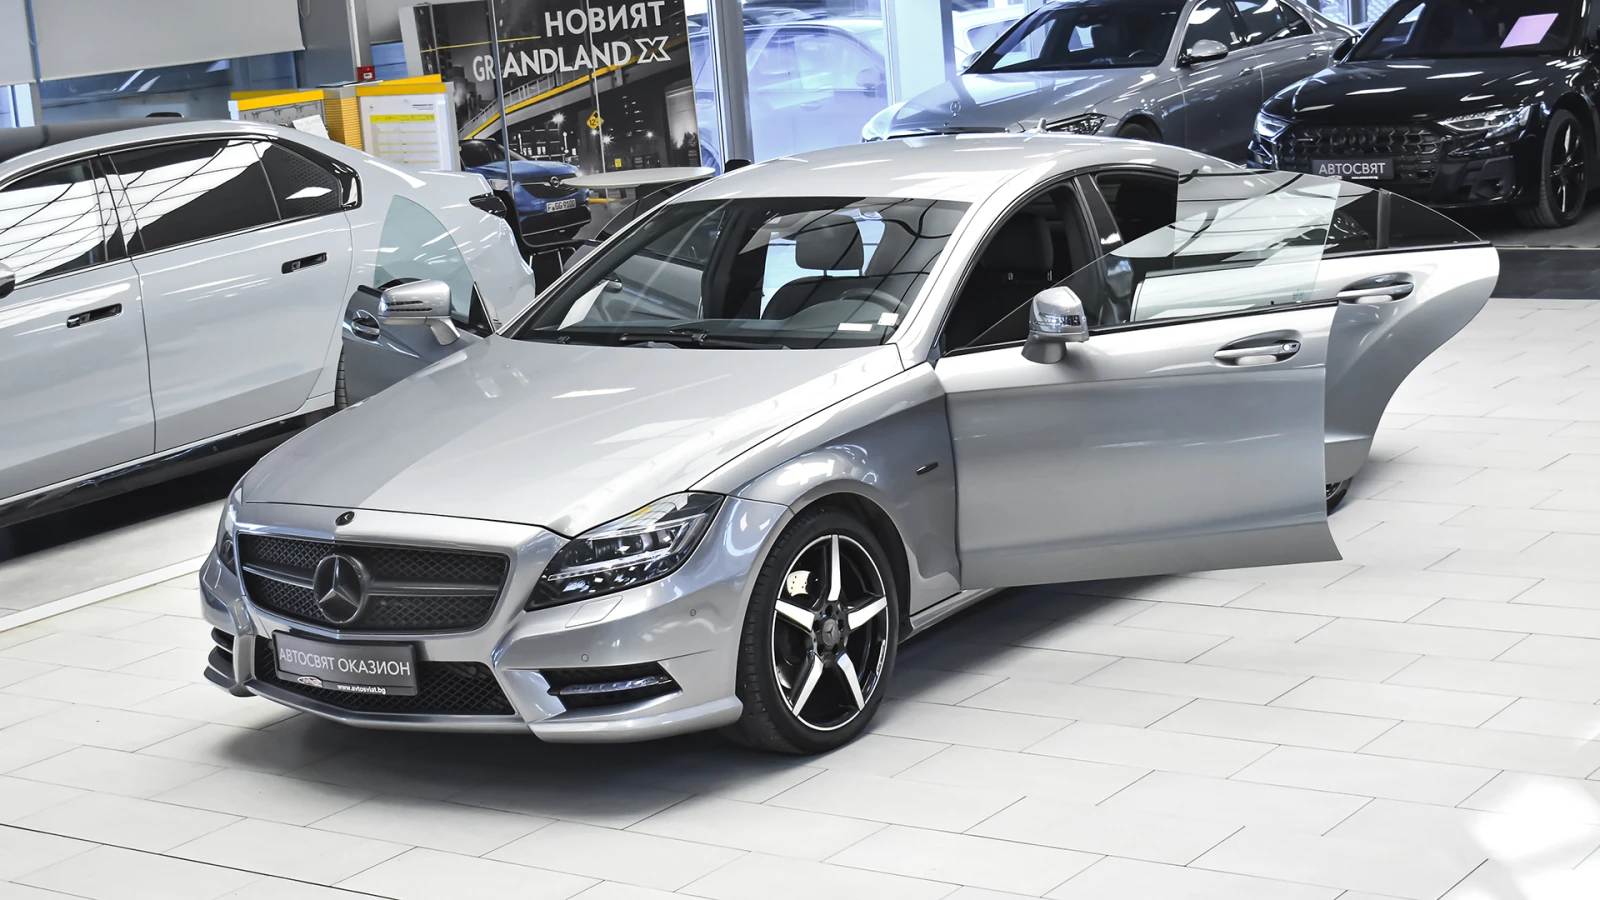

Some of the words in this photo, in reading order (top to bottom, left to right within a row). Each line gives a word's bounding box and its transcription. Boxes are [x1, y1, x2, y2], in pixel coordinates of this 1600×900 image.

[544, 1, 665, 37] НОВИЯТ
[1318, 162, 1386, 175] АВТОСВЯТ
[279, 648, 334, 670] АВТОСВЯТ
[337, 658, 411, 676] ОКАЗИОН
[337, 684, 387, 695] www.avtosviat.bg
